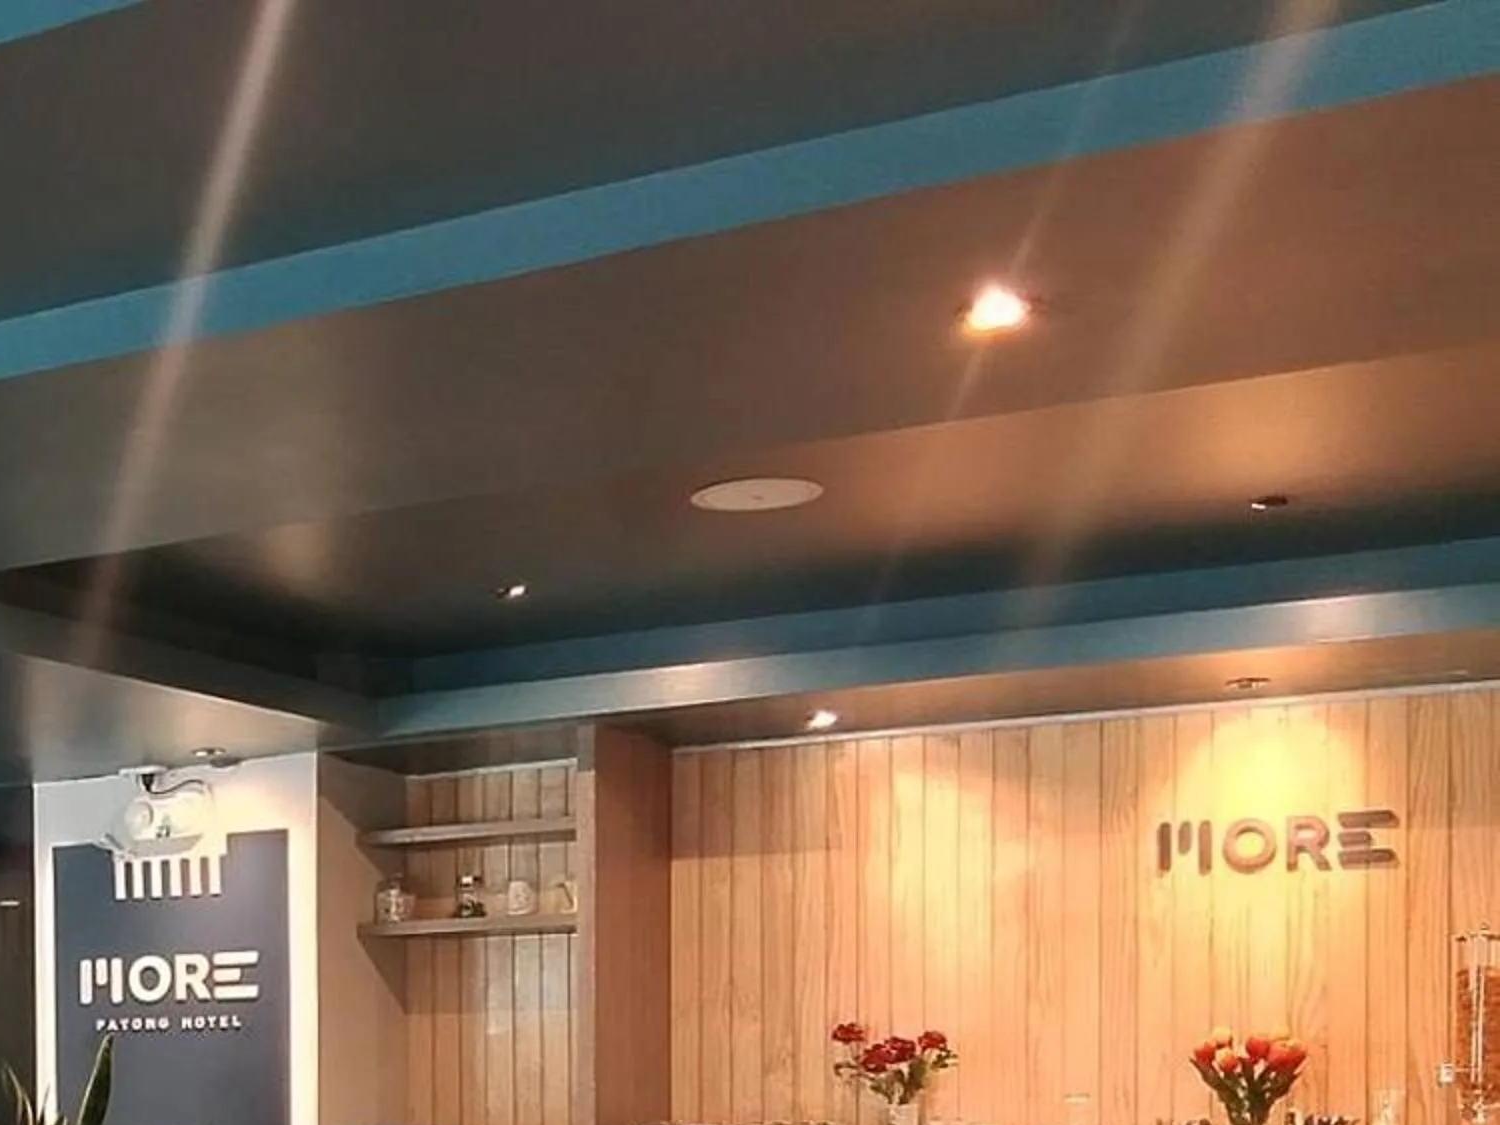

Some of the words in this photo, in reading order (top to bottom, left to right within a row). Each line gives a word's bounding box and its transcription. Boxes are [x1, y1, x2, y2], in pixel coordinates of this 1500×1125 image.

[1157, 809, 1400, 877] MORE
[78, 950, 260, 1006] MORE
[96, 1016, 170, 1032] PATONG
[180, 1014, 243, 1030] HOTEL
